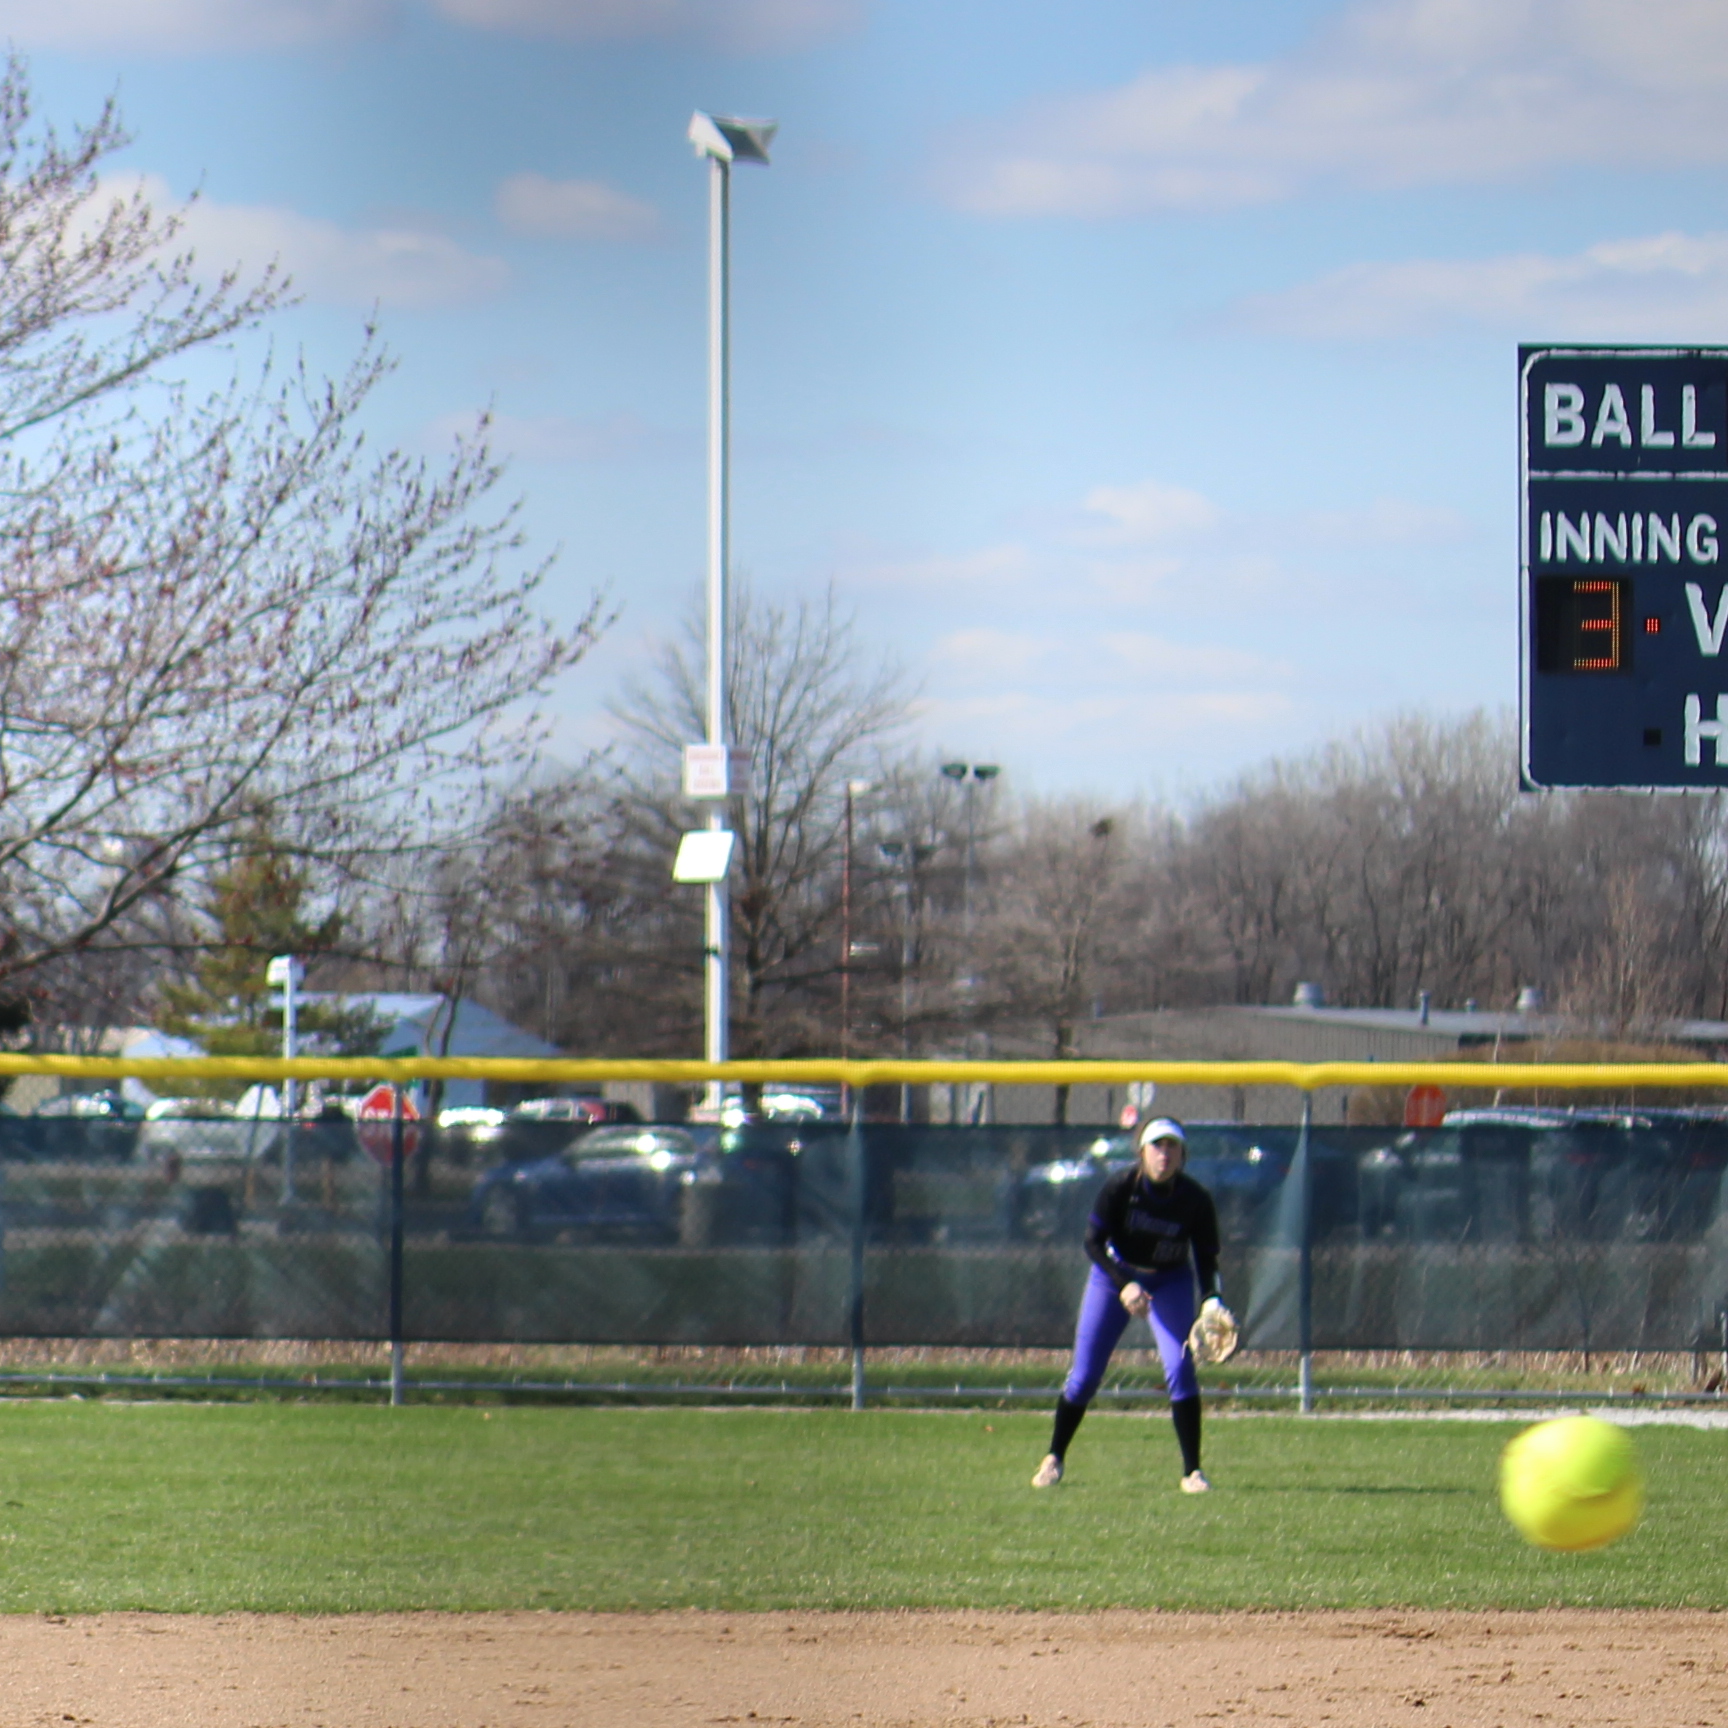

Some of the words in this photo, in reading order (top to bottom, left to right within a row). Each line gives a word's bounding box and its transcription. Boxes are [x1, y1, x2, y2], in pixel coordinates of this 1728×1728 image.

[1544, 382, 1716, 448] BALL
[1539, 511, 1719, 564] INNING
[1573, 580, 1620, 670] 3
